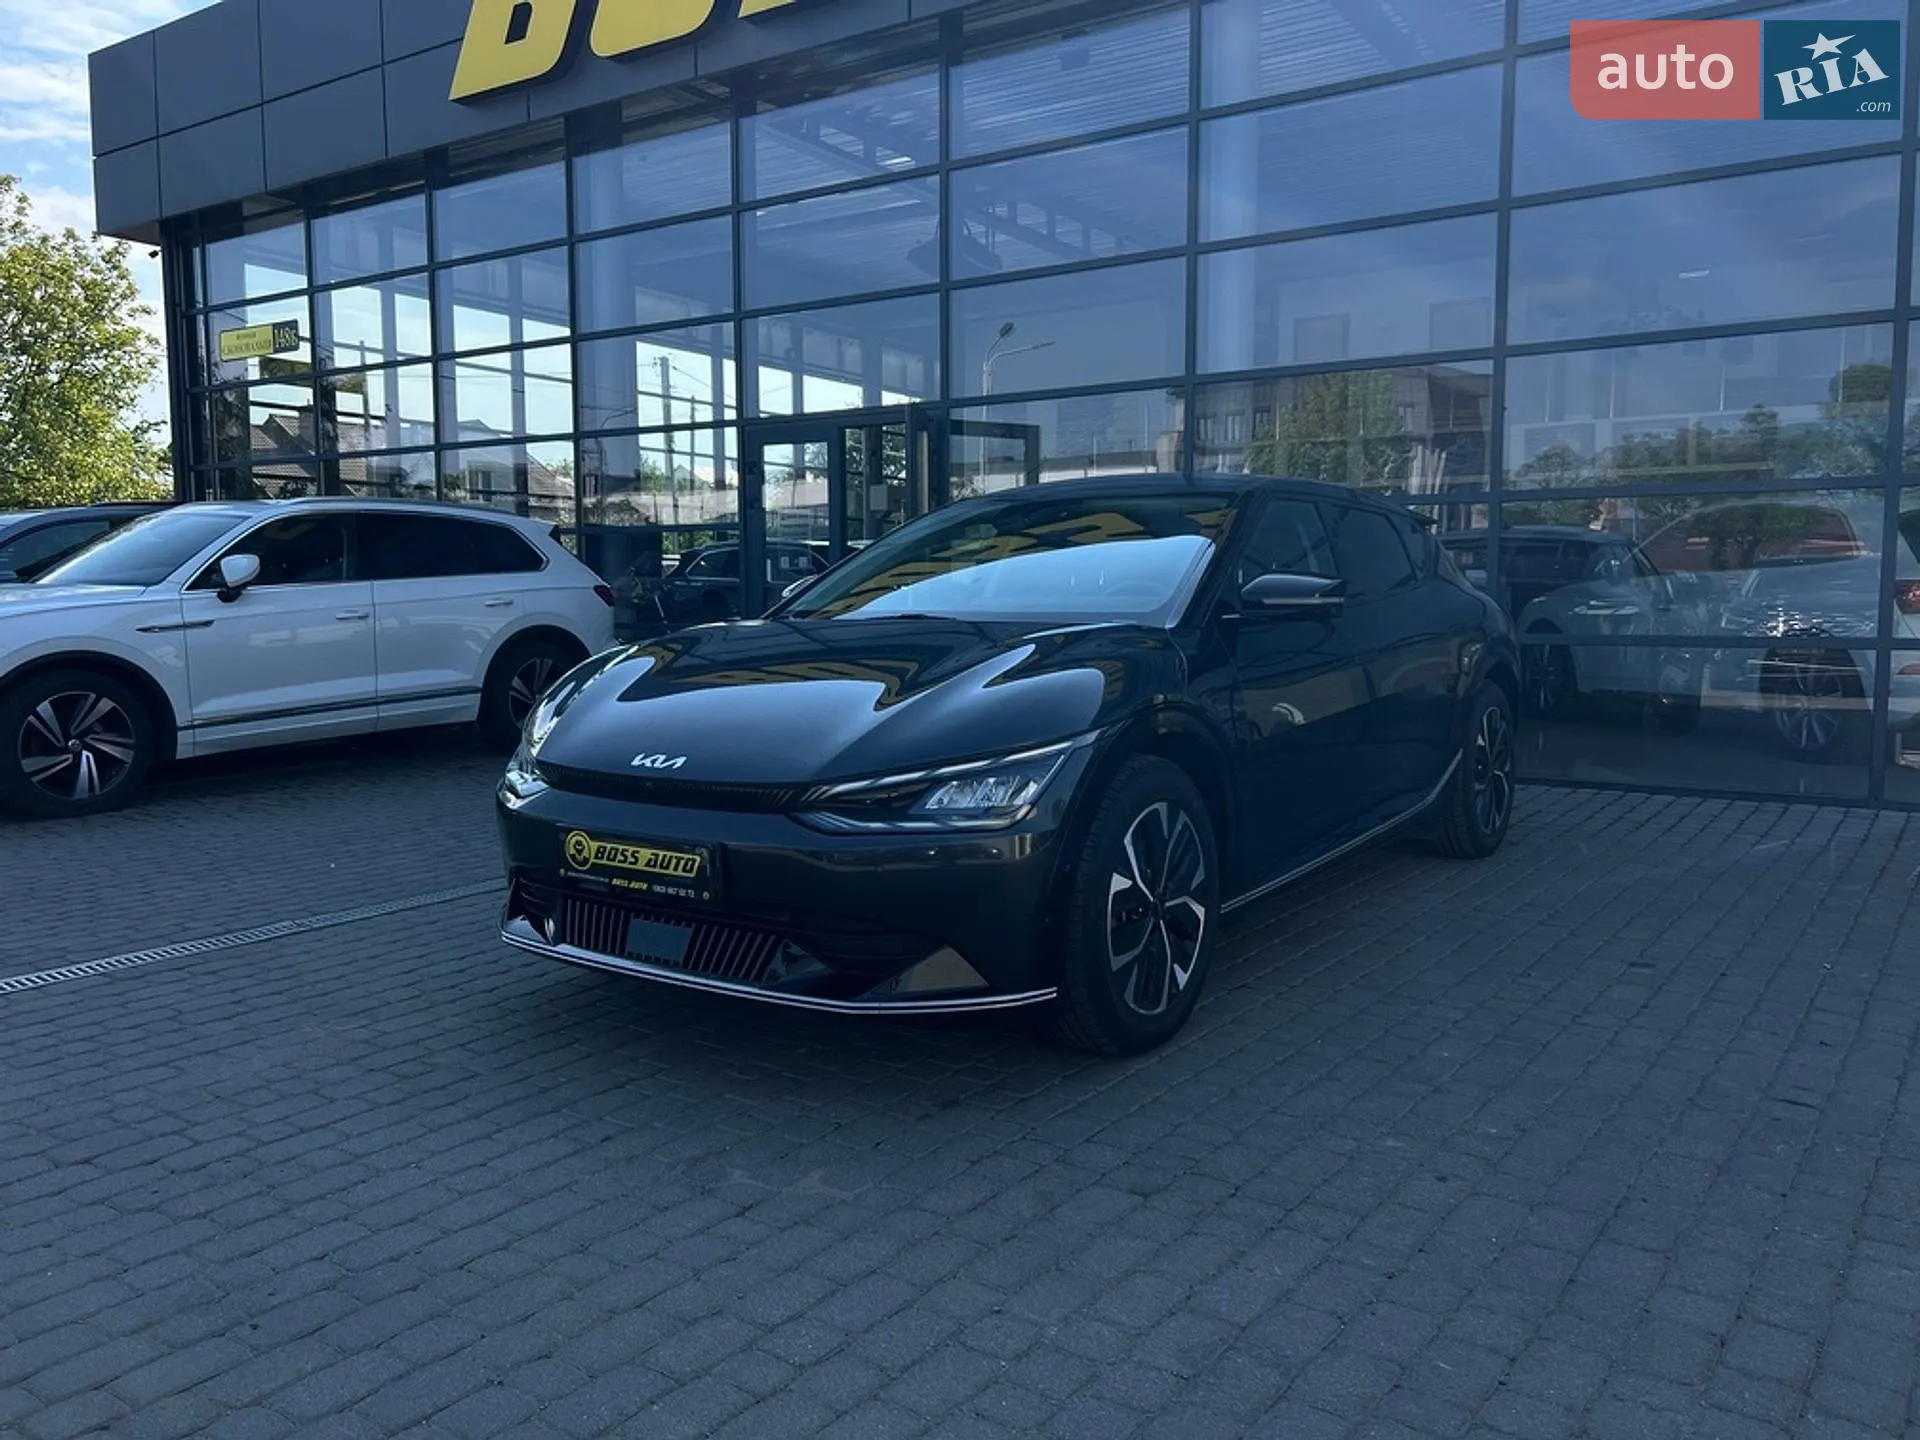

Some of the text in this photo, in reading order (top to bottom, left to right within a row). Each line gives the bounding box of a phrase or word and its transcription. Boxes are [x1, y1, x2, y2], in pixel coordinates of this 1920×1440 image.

[630, 753, 688, 769] KIA
[594, 844, 697, 874] BOSS AUTO
